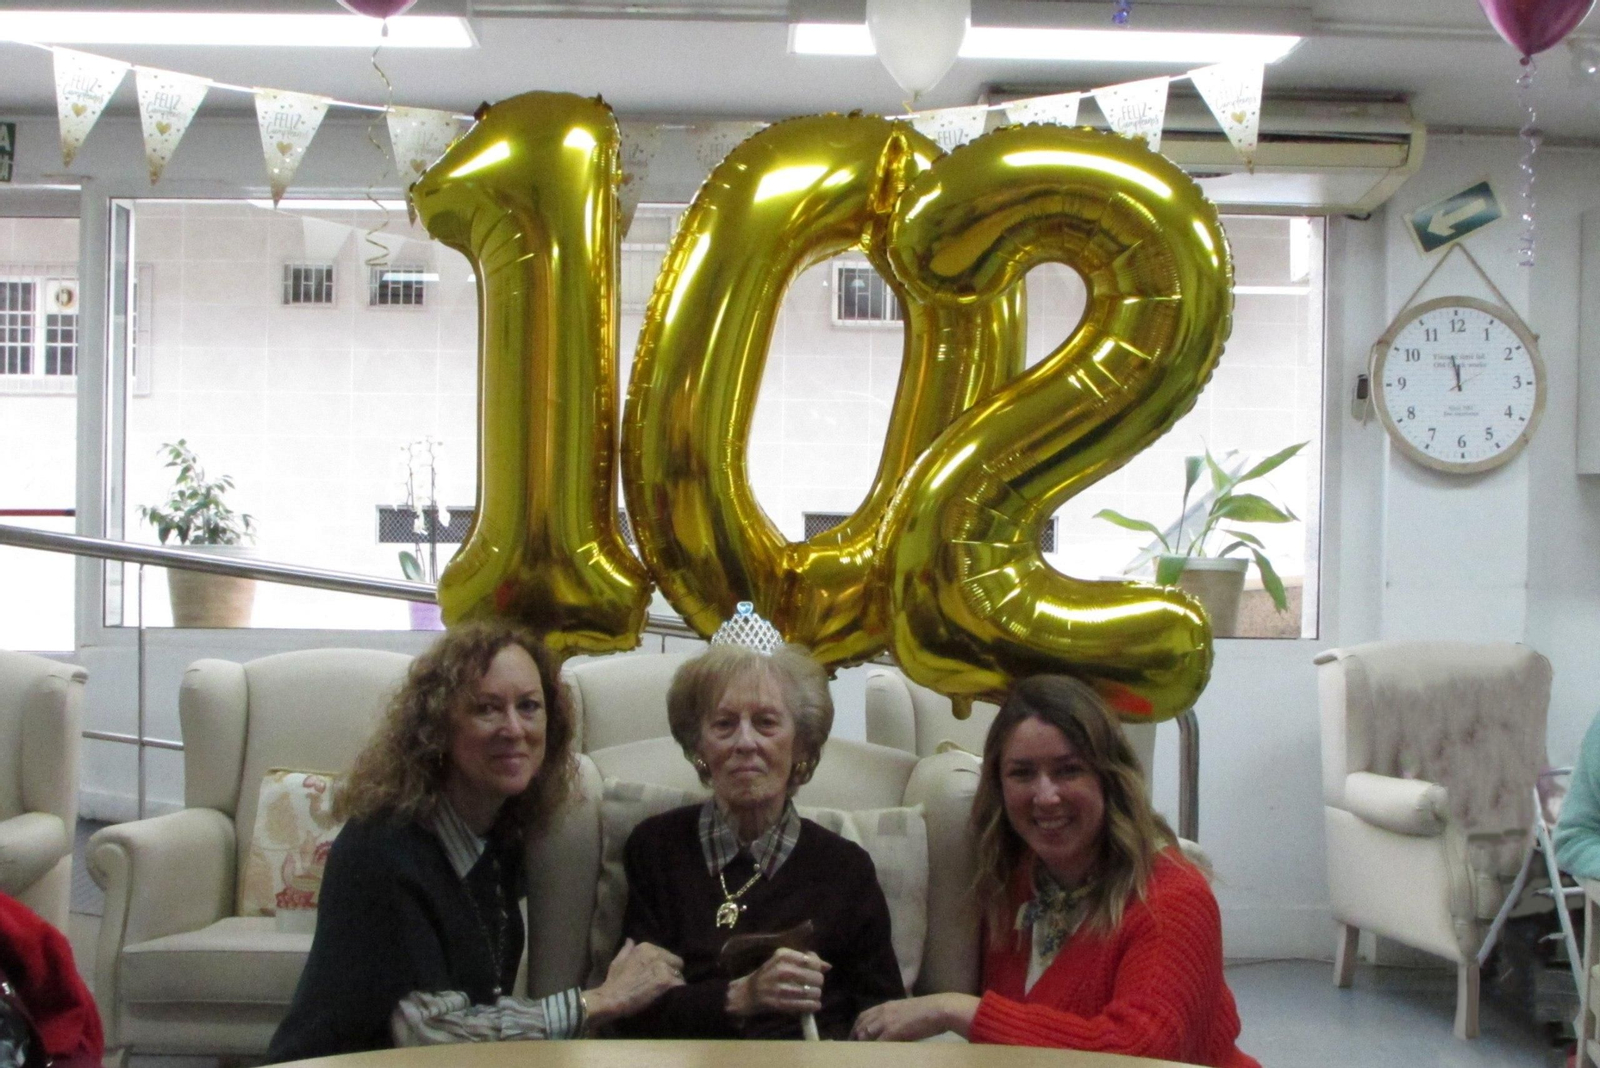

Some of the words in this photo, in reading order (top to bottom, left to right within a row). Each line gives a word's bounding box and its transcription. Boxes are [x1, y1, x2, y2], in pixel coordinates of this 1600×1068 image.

[153, 91, 181, 111] FELIZ
[1121, 102, 1147, 120] FELIZ
[273, 112, 302, 131] FELIZ
[937, 128, 964, 146] FELIZ
[1450, 319, 1466, 333] 12
[1425, 328, 1439, 342] 11
[1484, 328, 1490, 341] 1
[1405, 348, 1421, 362] 10
[1504, 347, 1513, 361] 2
[1397, 377, 1407, 390] 9
[1512, 375, 1522, 389] 3
[1407, 406, 1416, 420] 8
[1504, 405, 1513, 418] 4
[1427, 428, 1437, 441] 7
[1457, 434, 1467, 448] 6
[1485, 427, 1494, 441] 5
